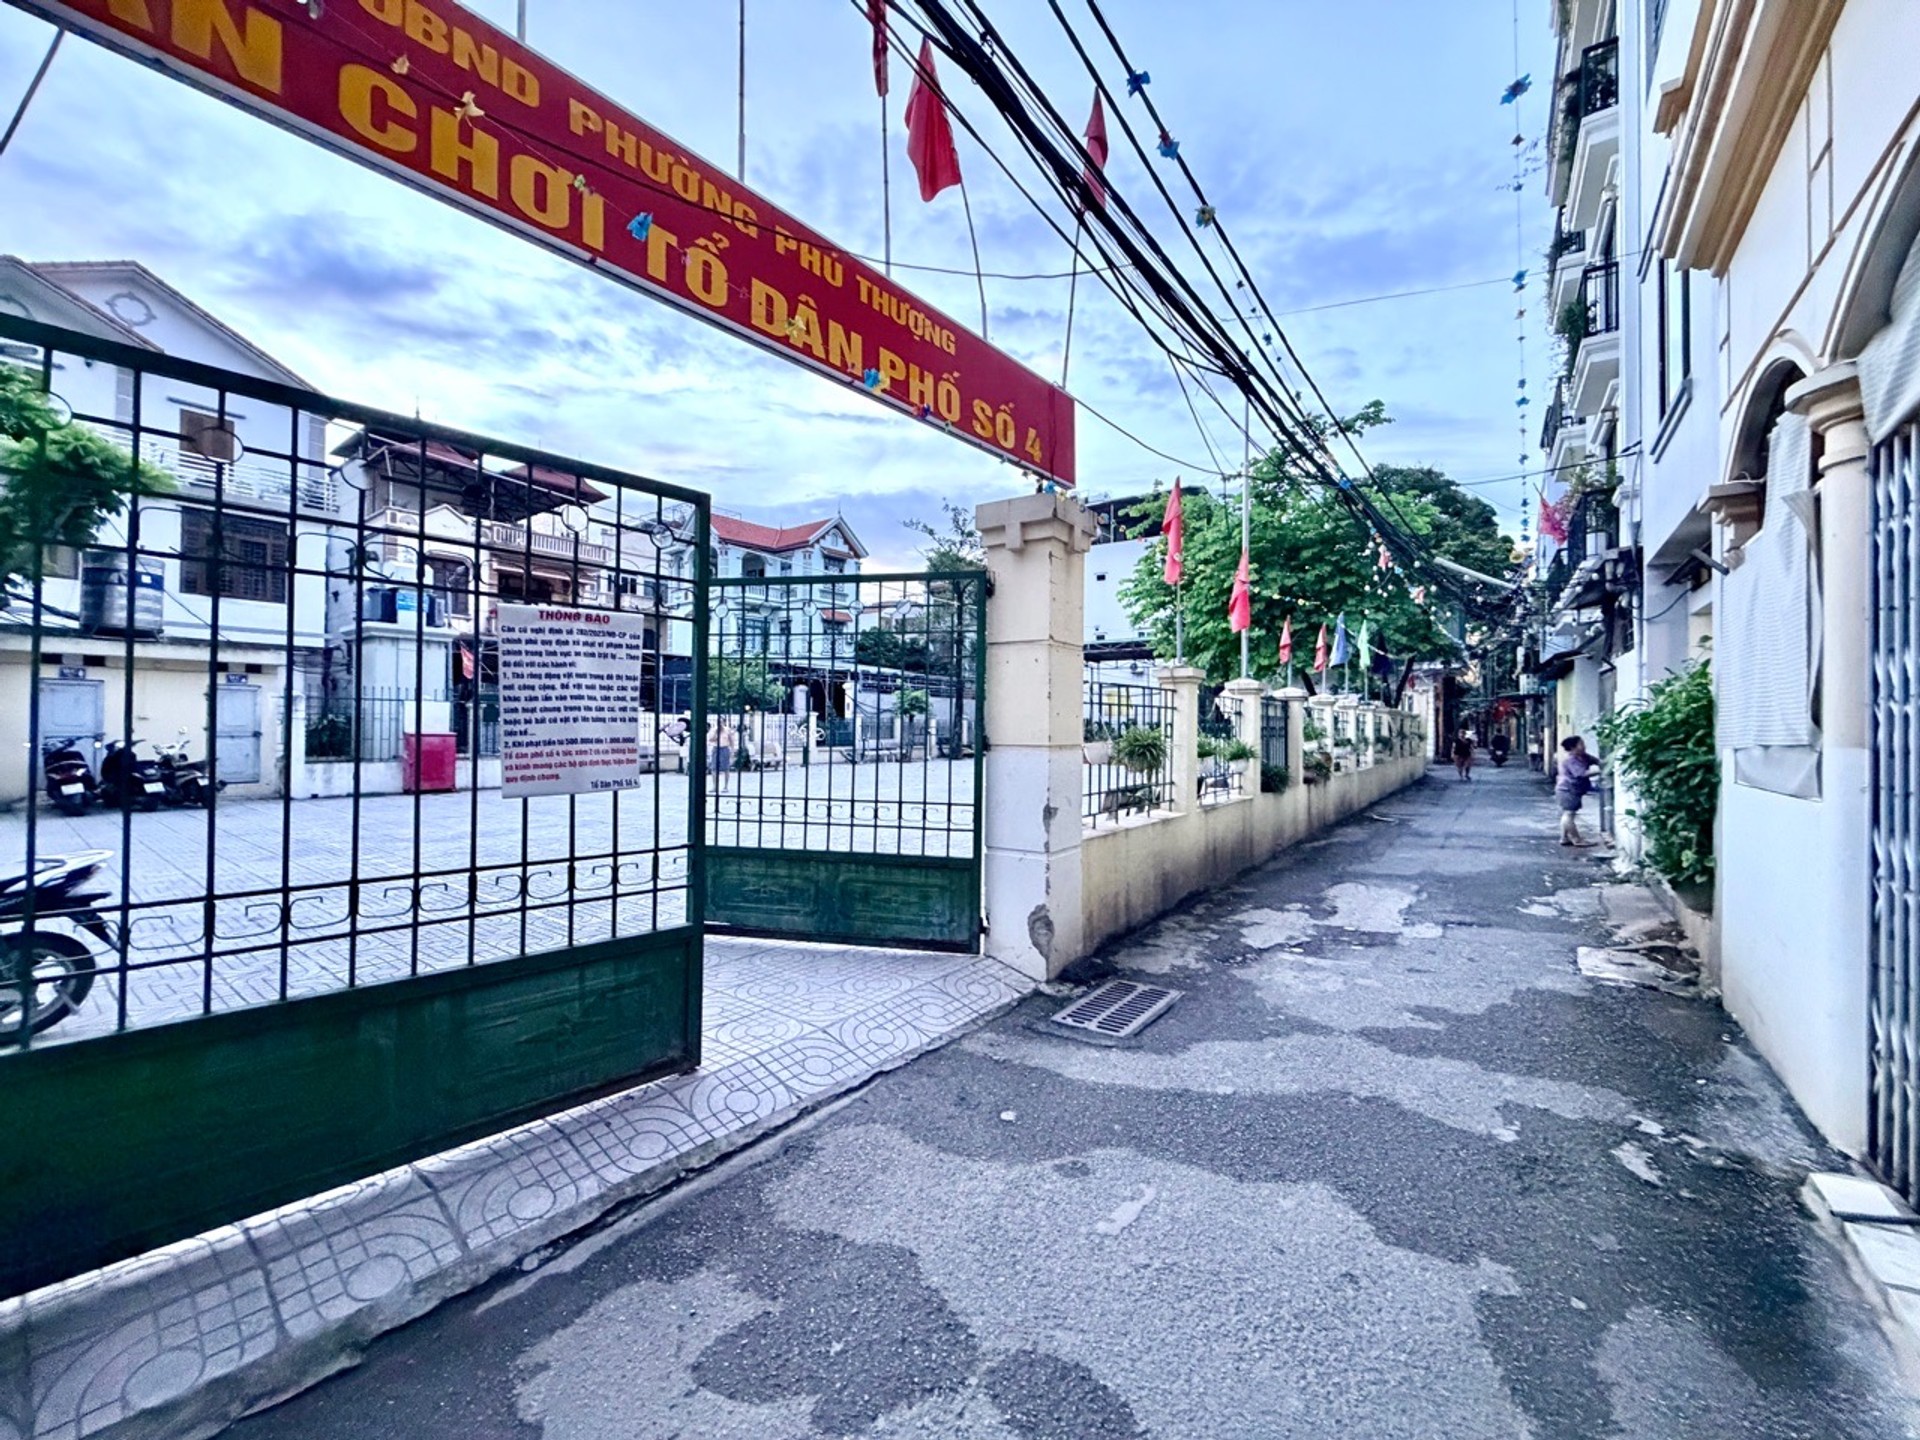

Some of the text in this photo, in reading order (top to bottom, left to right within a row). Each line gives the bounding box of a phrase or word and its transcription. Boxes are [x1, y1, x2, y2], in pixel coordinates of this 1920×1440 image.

[338, 63, 604, 251] CHƠI
[645, 223, 730, 308] TỔ
[751, 277, 862, 377] DÂN
[879, 346, 961, 423] PHỐ
[972, 398, 1015, 449] SỐ
[1025, 427, 1043, 463] 4
[569, 97, 758, 239] PHƯỜNG
[856, 274, 956, 356] THƯỢNG
